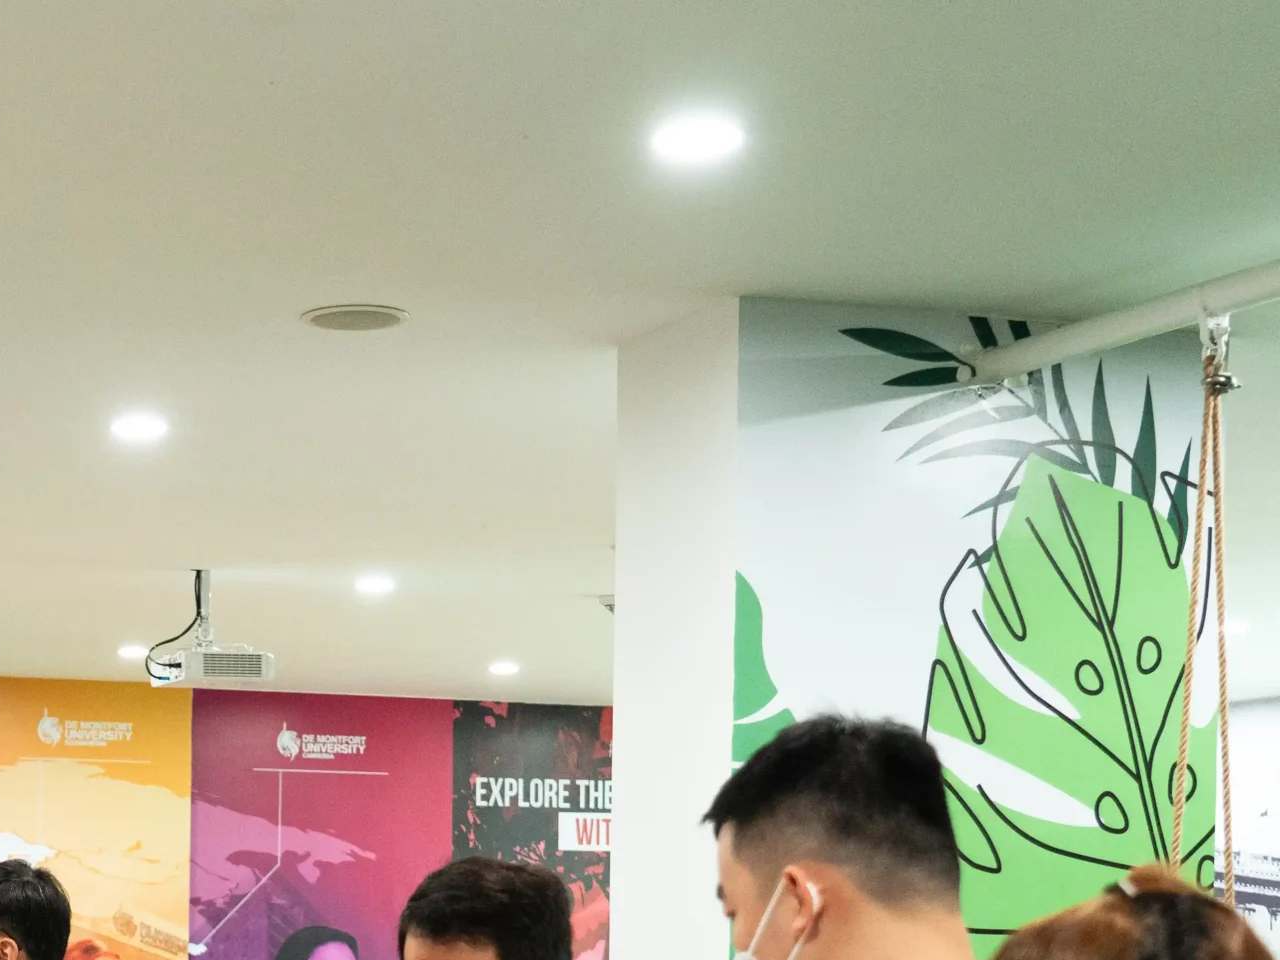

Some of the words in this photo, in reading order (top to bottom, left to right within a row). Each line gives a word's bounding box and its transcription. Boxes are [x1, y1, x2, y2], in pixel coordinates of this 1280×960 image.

[65, 720, 78, 729] DE
[80, 721, 133, 731] MONTFORT
[65, 729, 133, 741] UNIVERSITY
[302, 734, 315, 743] DE
[317, 735, 366, 745] MONTFORT
[302, 743, 366, 754] UNIVERSITY
[475, 777, 571, 808] EXPLORE
